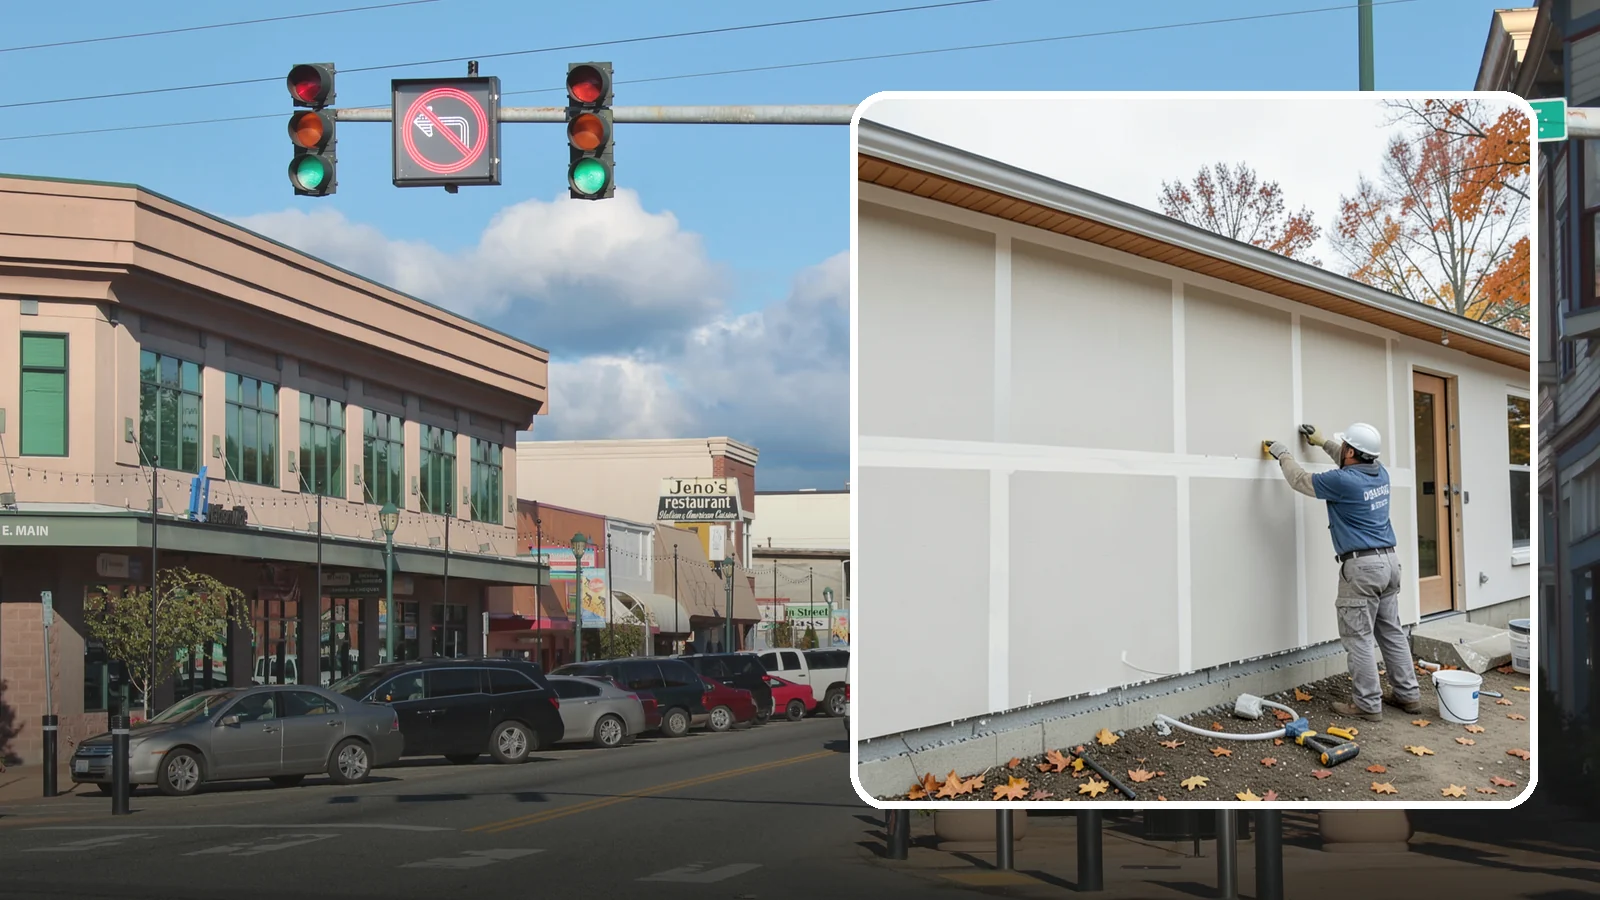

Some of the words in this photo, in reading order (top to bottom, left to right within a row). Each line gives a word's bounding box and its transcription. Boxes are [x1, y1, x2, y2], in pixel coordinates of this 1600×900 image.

[670, 480, 727, 494] Jeno's
[665, 496, 731, 509] restaurant
[659, 510, 681, 519] Italian
[686, 510, 714, 519] American
[714, 509, 737, 519] Cuisine
[2, 525, 13, 536] E.
[16, 525, 48, 536] MAIN
[798, 607, 828, 616] Street
[791, 619, 823, 627] lass
